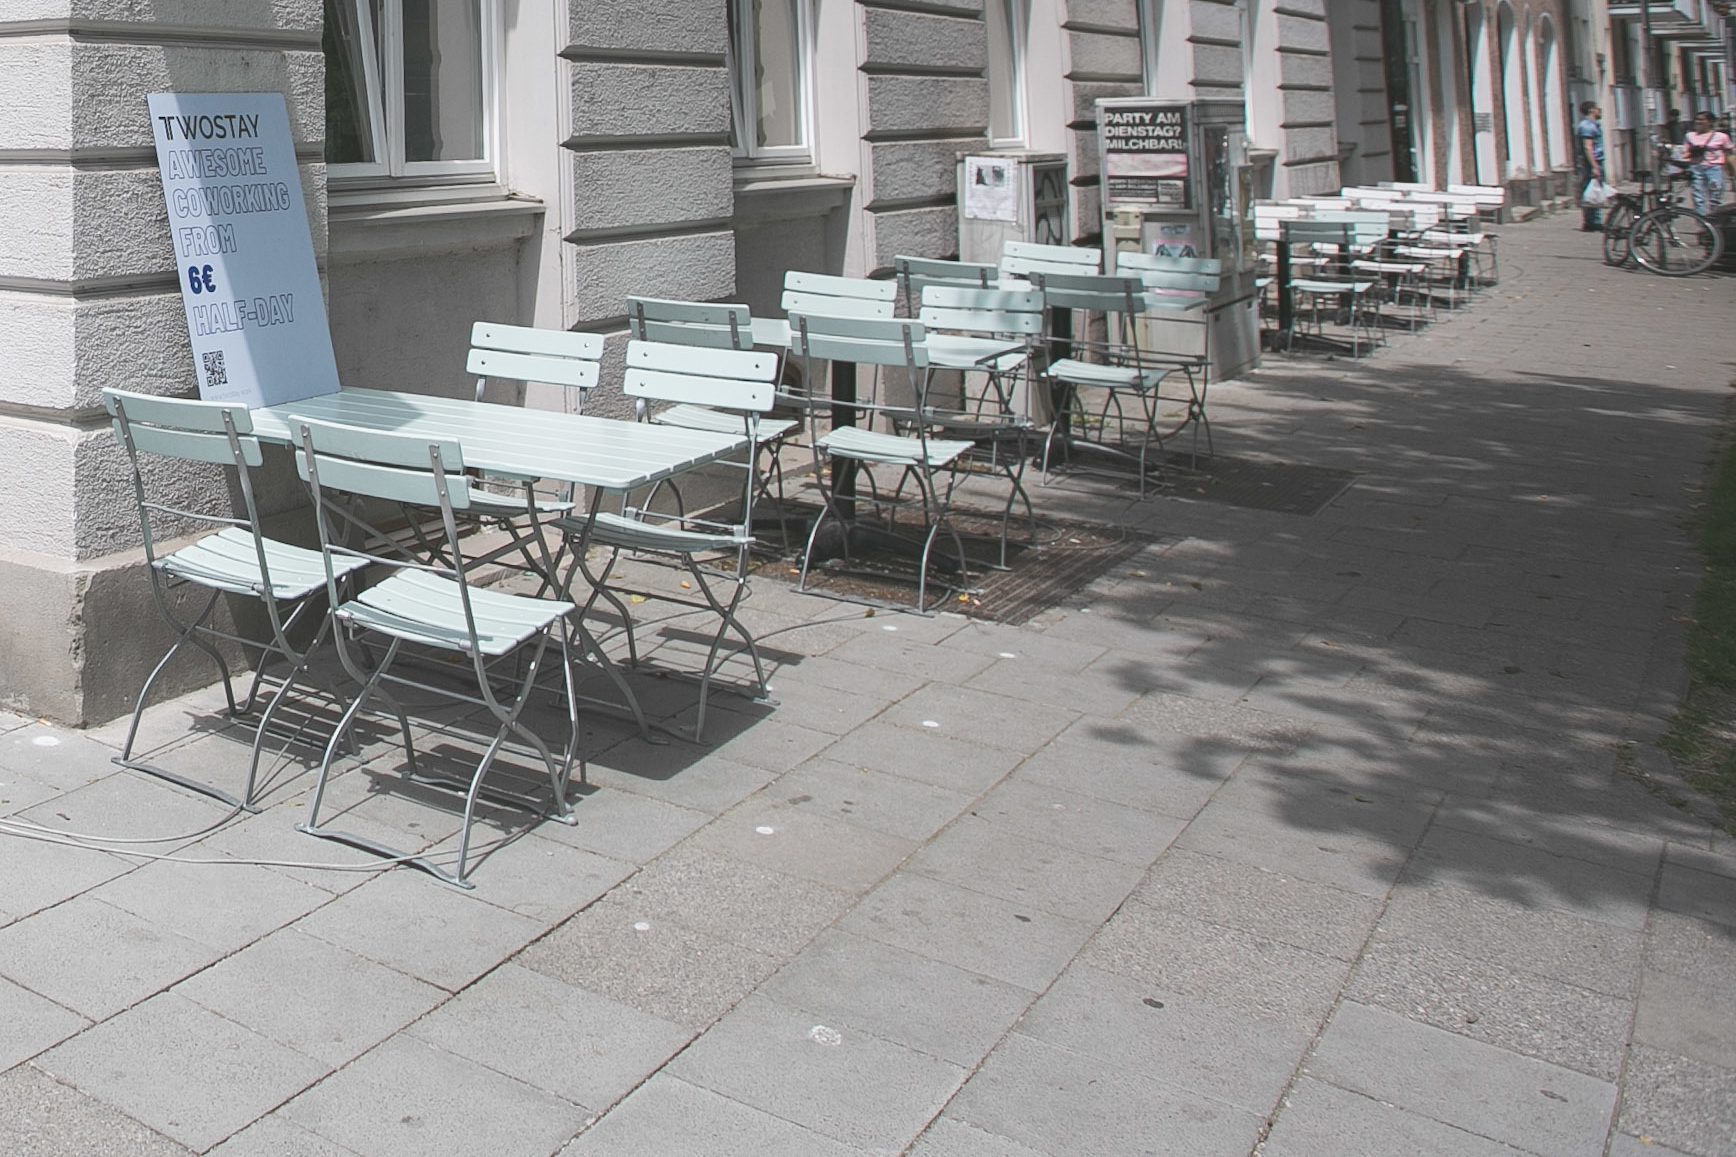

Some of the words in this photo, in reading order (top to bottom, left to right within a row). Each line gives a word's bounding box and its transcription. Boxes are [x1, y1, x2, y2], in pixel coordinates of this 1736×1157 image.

[158, 113, 260, 141] TWOSTAY
[1105, 112, 1153, 124] PARTY
[1155, 112, 1181, 124] AM
[1105, 126, 1182, 137] DIENSTAG?
[1105, 138, 1184, 150] MILCHBAR!
[168, 146, 268, 180] AWESOME
[172, 181, 291, 219] COWORKING
[178, 223, 238, 258] FROM
[187, 264, 217, 294] 6€
[192, 292, 296, 337] HALF-DAY
